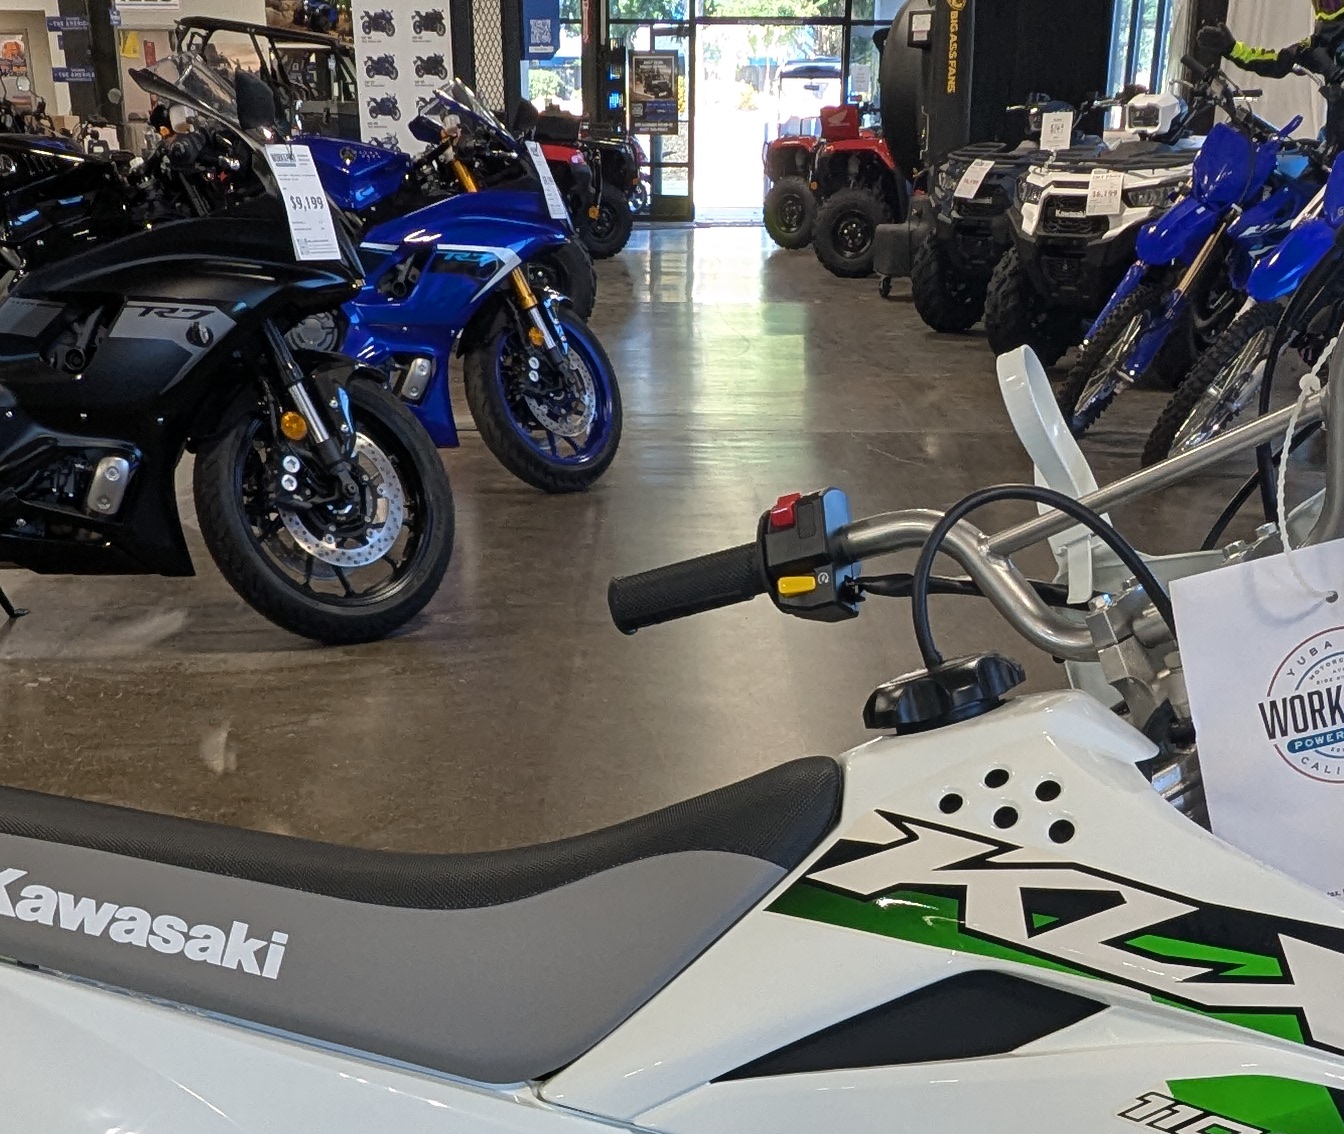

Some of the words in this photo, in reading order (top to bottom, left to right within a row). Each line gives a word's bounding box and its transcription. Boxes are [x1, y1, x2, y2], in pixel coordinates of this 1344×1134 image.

[948, 33, 958, 59] ASS
[289, 195, 325, 212] $9,199
[1285, 640, 1333, 678] YUBA
